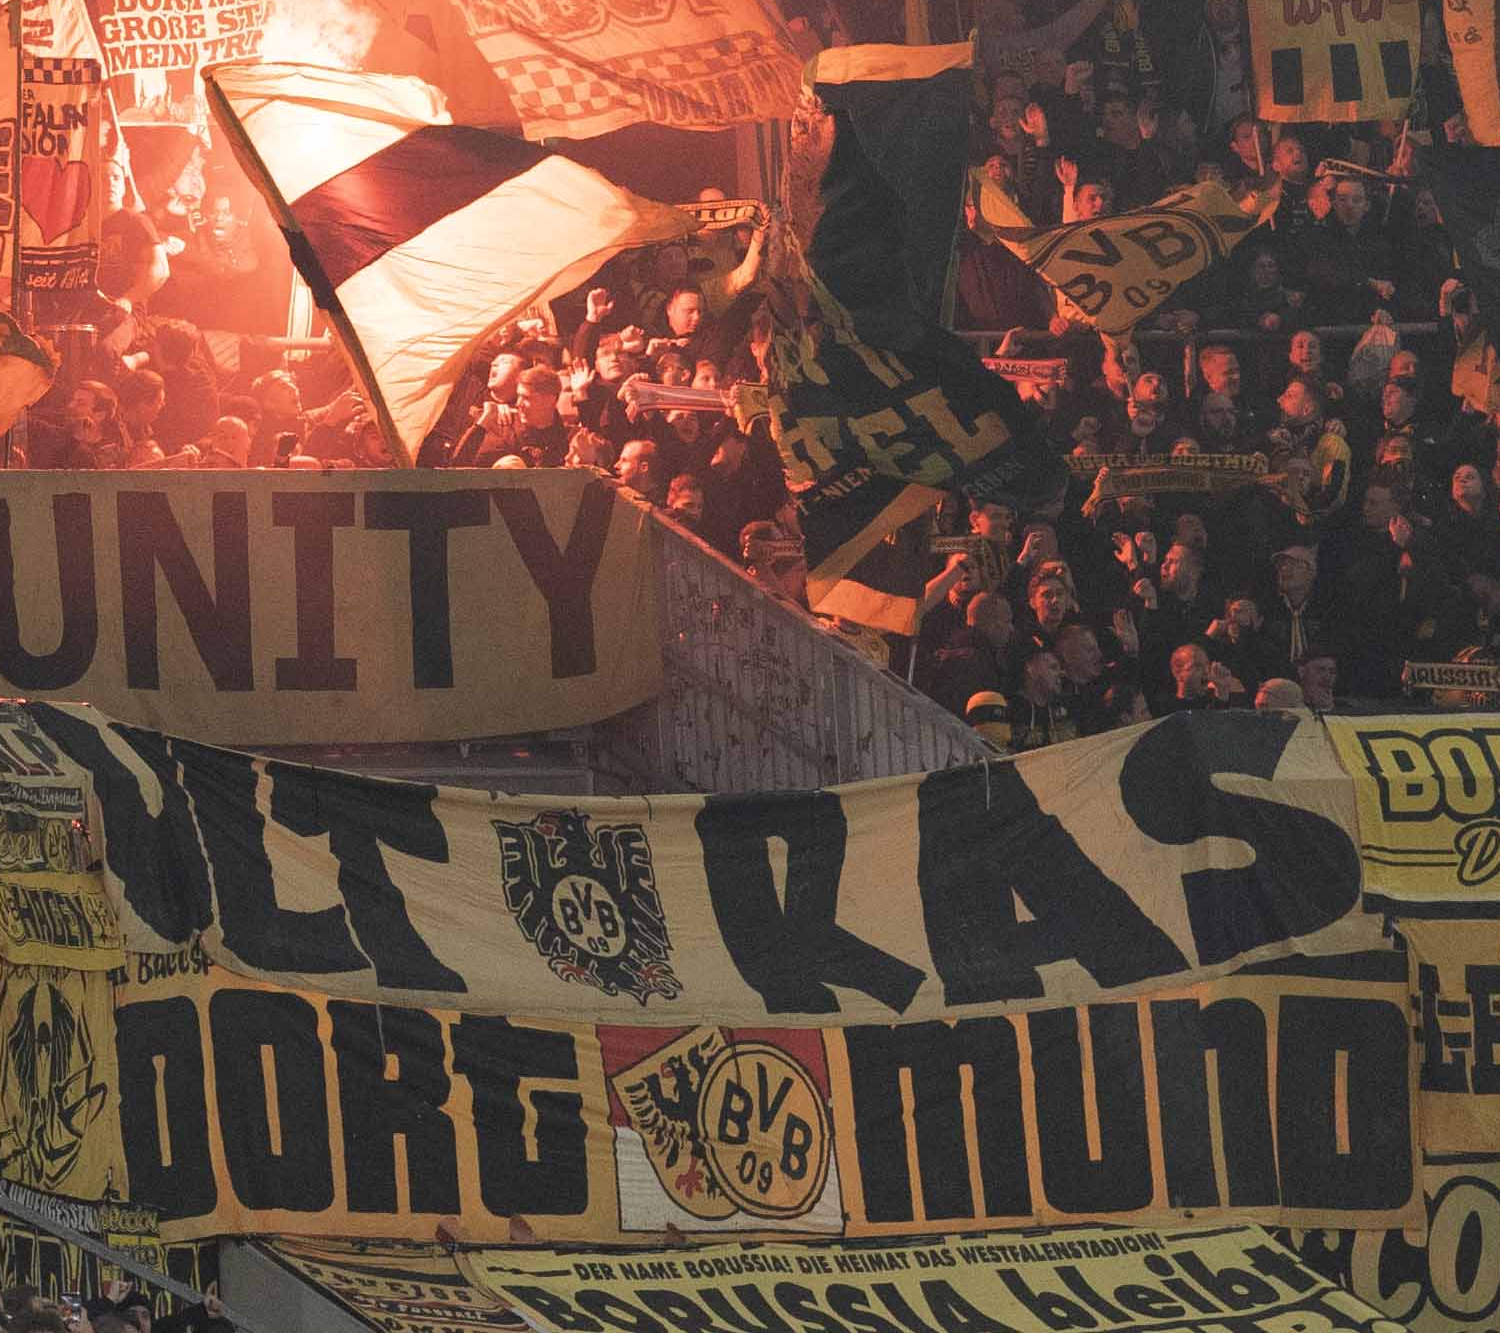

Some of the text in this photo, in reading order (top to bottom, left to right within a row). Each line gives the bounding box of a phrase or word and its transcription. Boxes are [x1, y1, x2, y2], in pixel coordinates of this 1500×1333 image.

[110, 42, 198, 74] MEIN
[1061, 218, 1198, 316] BVB
[1124, 277, 1175, 308] 09
[1411, 665, 1491, 689] RUSSIA
[559, 881, 620, 939] BVB
[718, 1061, 813, 1181] BVB
[739, 1150, 773, 1193] 09
[576, 1232, 1165, 1282] DER NAME BORUSSIA! DIE HEIMAT DAS WESTFALENSTADION!
[502, 1277, 1019, 1333] BORUSSIA
